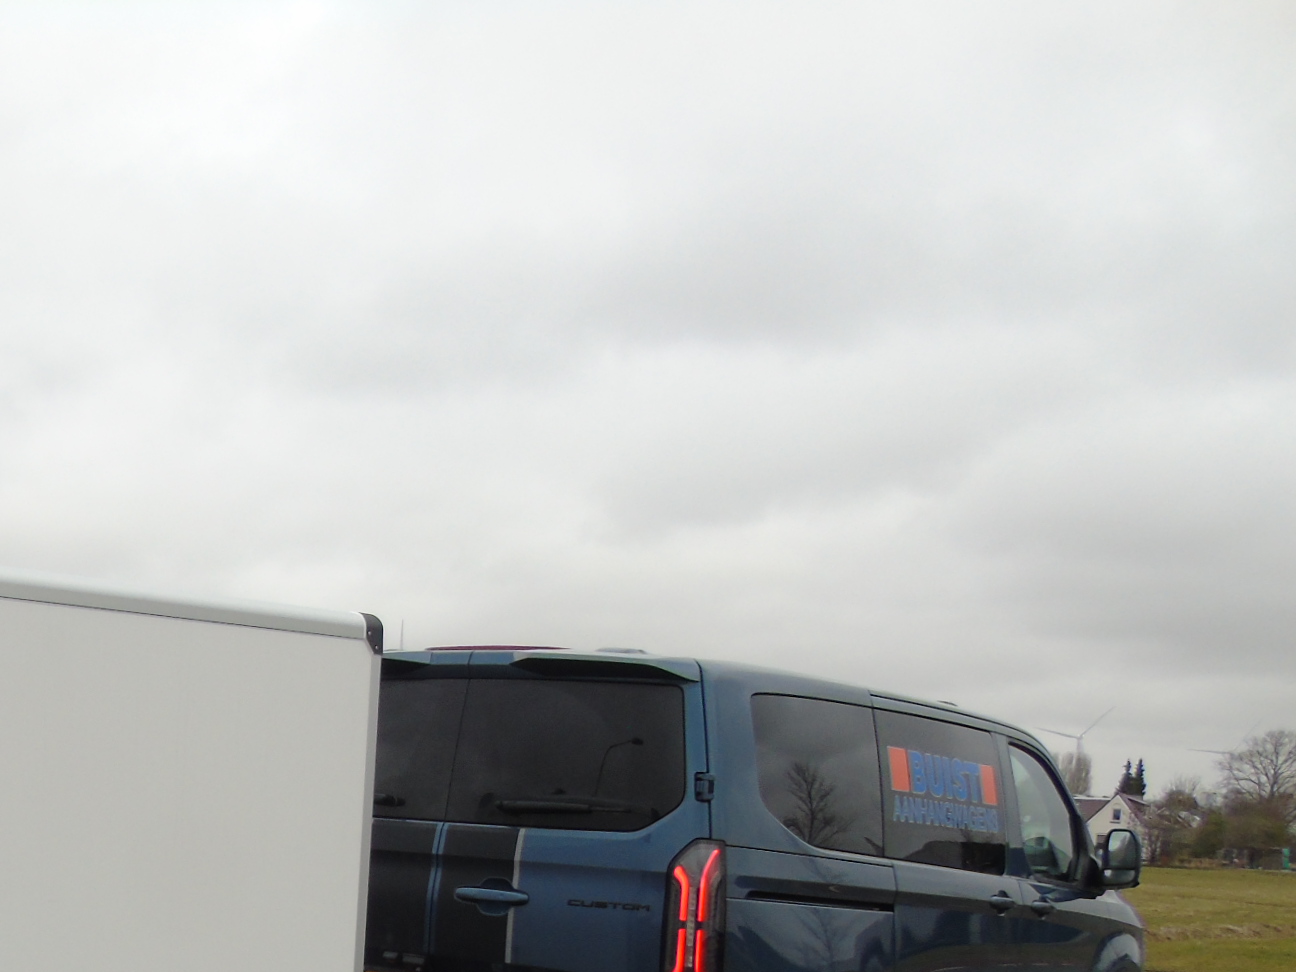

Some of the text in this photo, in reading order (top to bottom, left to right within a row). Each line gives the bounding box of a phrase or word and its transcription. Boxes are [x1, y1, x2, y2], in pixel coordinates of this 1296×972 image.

[908, 750, 981, 803] BUIST
[893, 795, 999, 833] AANHANGWAGENS
[567, 899, 651, 911] CUSTOM
